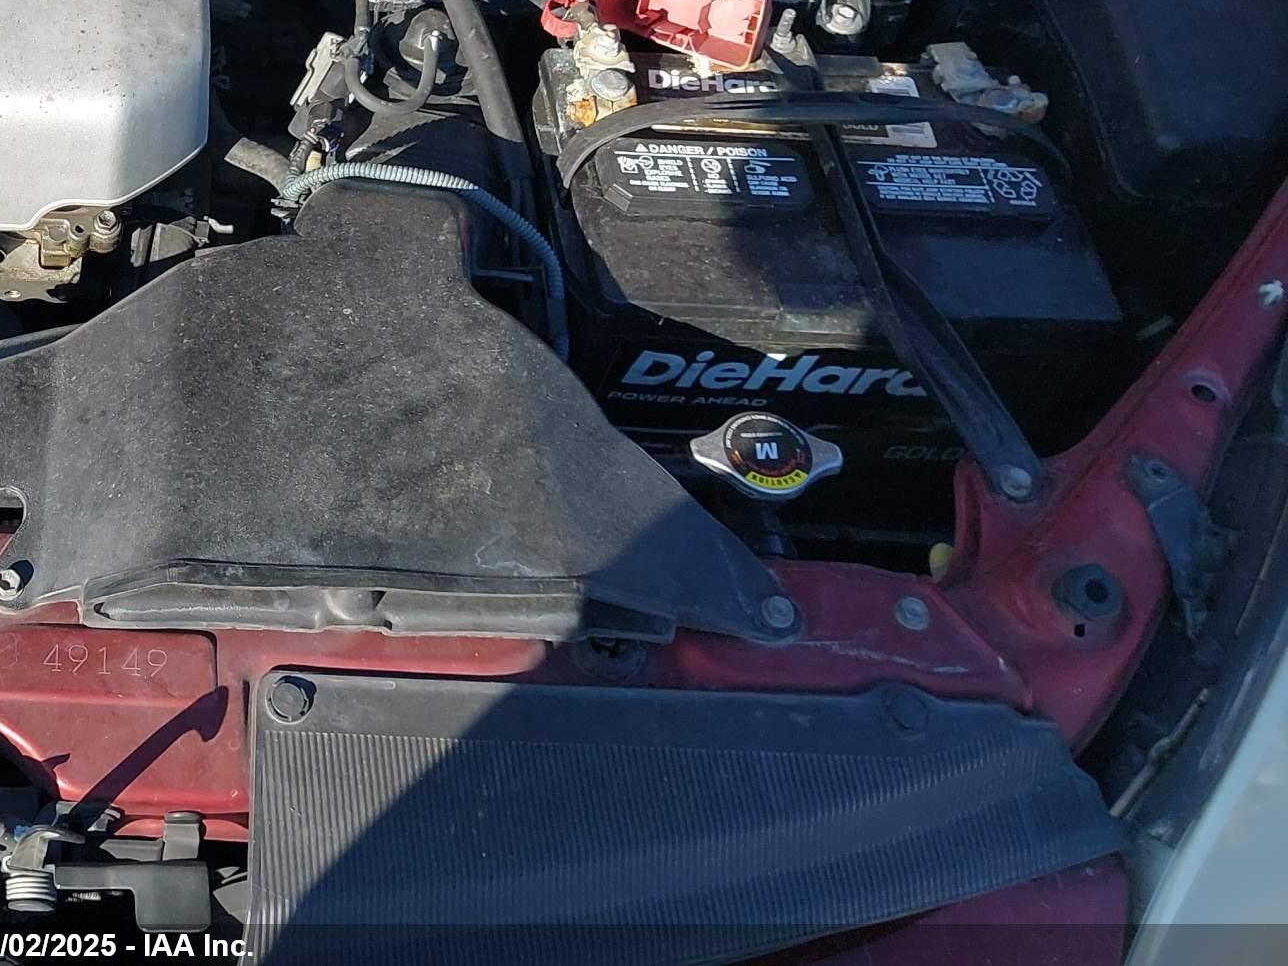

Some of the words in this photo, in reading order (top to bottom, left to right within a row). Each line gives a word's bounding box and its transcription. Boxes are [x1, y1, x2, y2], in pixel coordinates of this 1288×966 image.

[648, 144, 704, 155] DANGER
[717, 147, 768, 158] POISON
[607, 391, 686, 404] POWER
[692, 395, 768, 407] AHEAD
[43, 643, 168, 678] 49149
